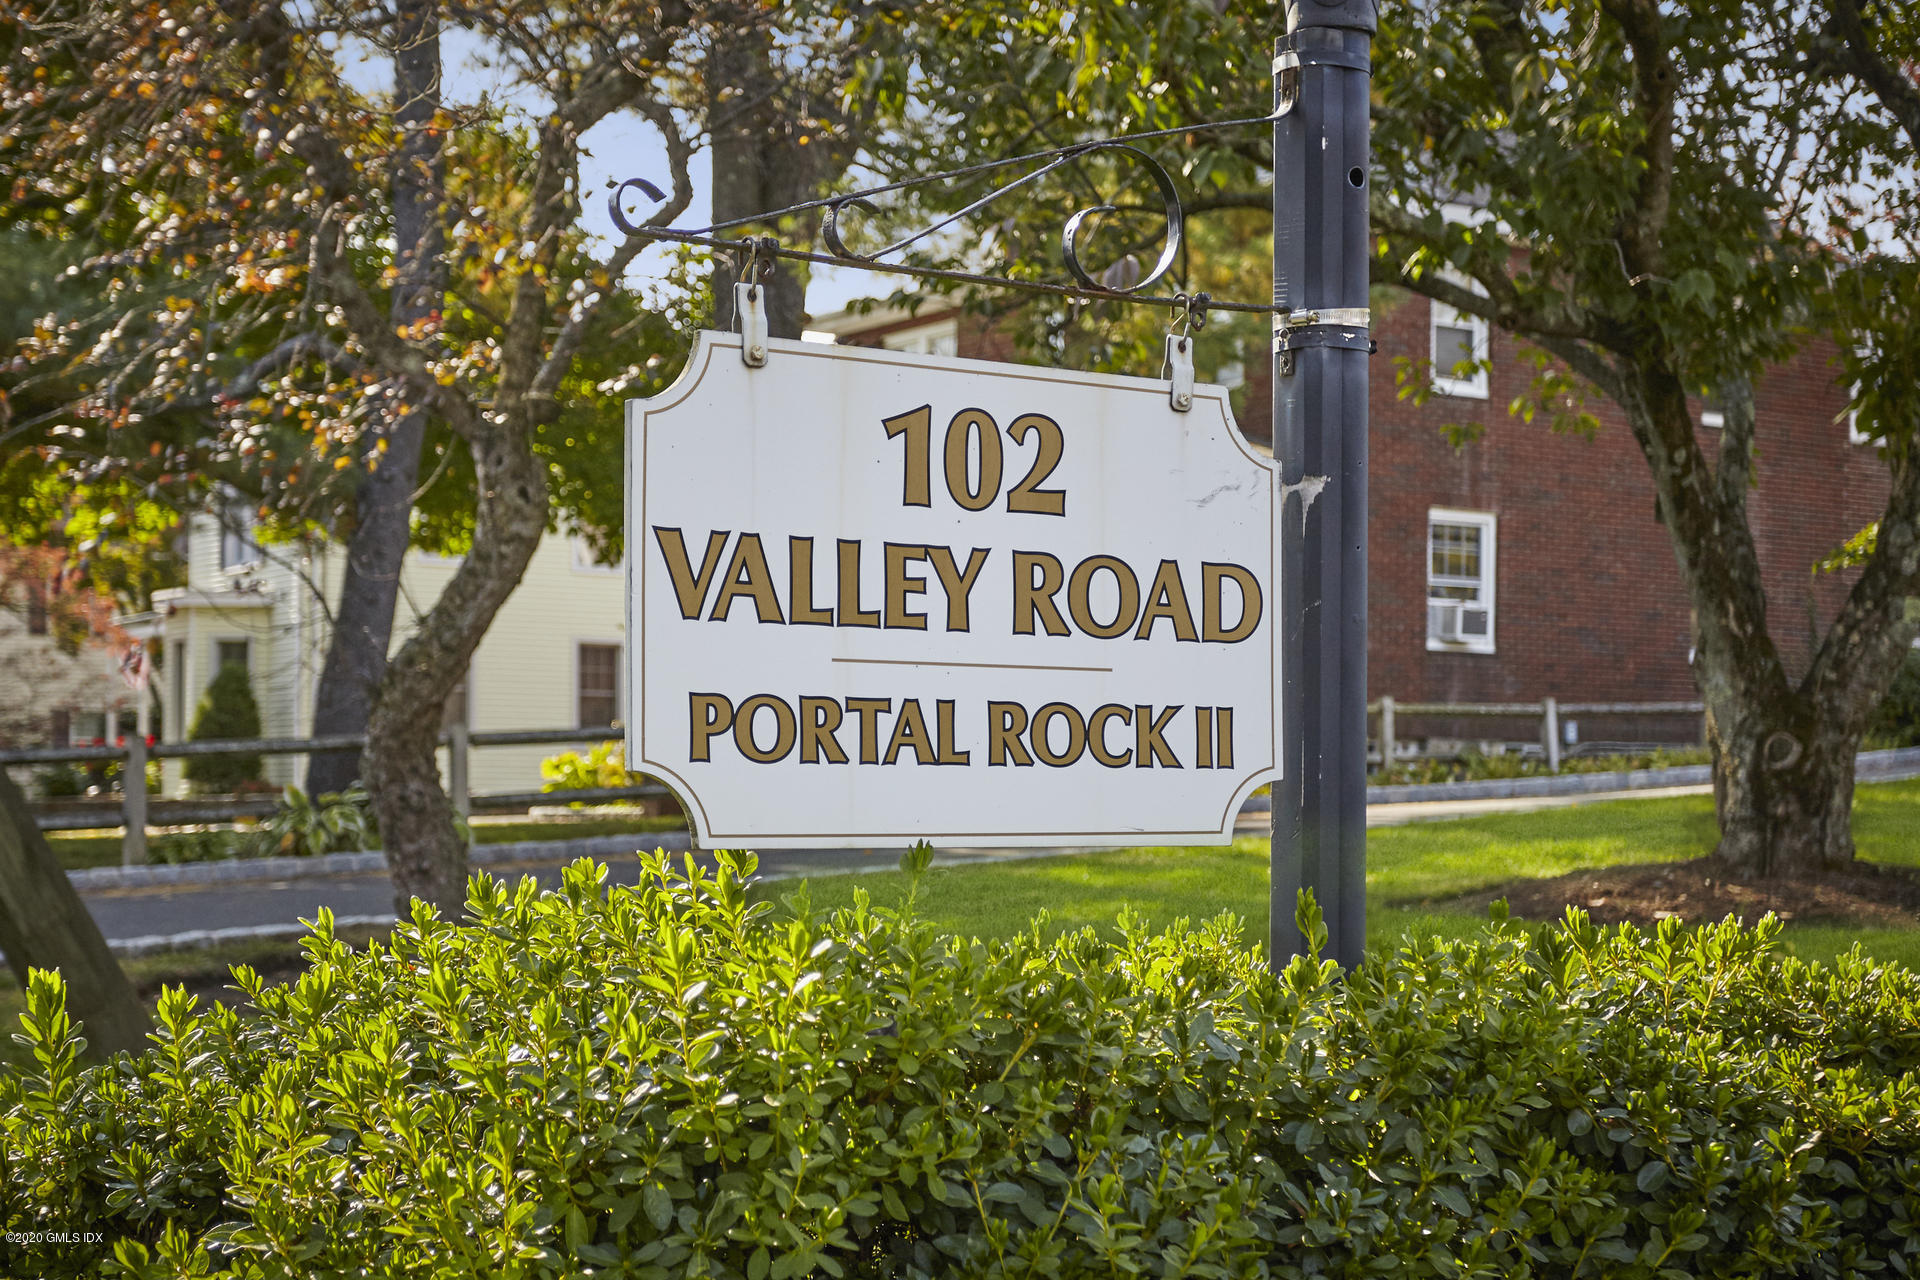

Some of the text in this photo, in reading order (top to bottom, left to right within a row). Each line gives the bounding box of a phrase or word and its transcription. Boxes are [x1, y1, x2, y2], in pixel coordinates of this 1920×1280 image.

[881, 404, 1066, 516] 102
[652, 525, 1263, 643] VALLEY ROAD
[689, 692, 1234, 769] PORTAL ROCK II
